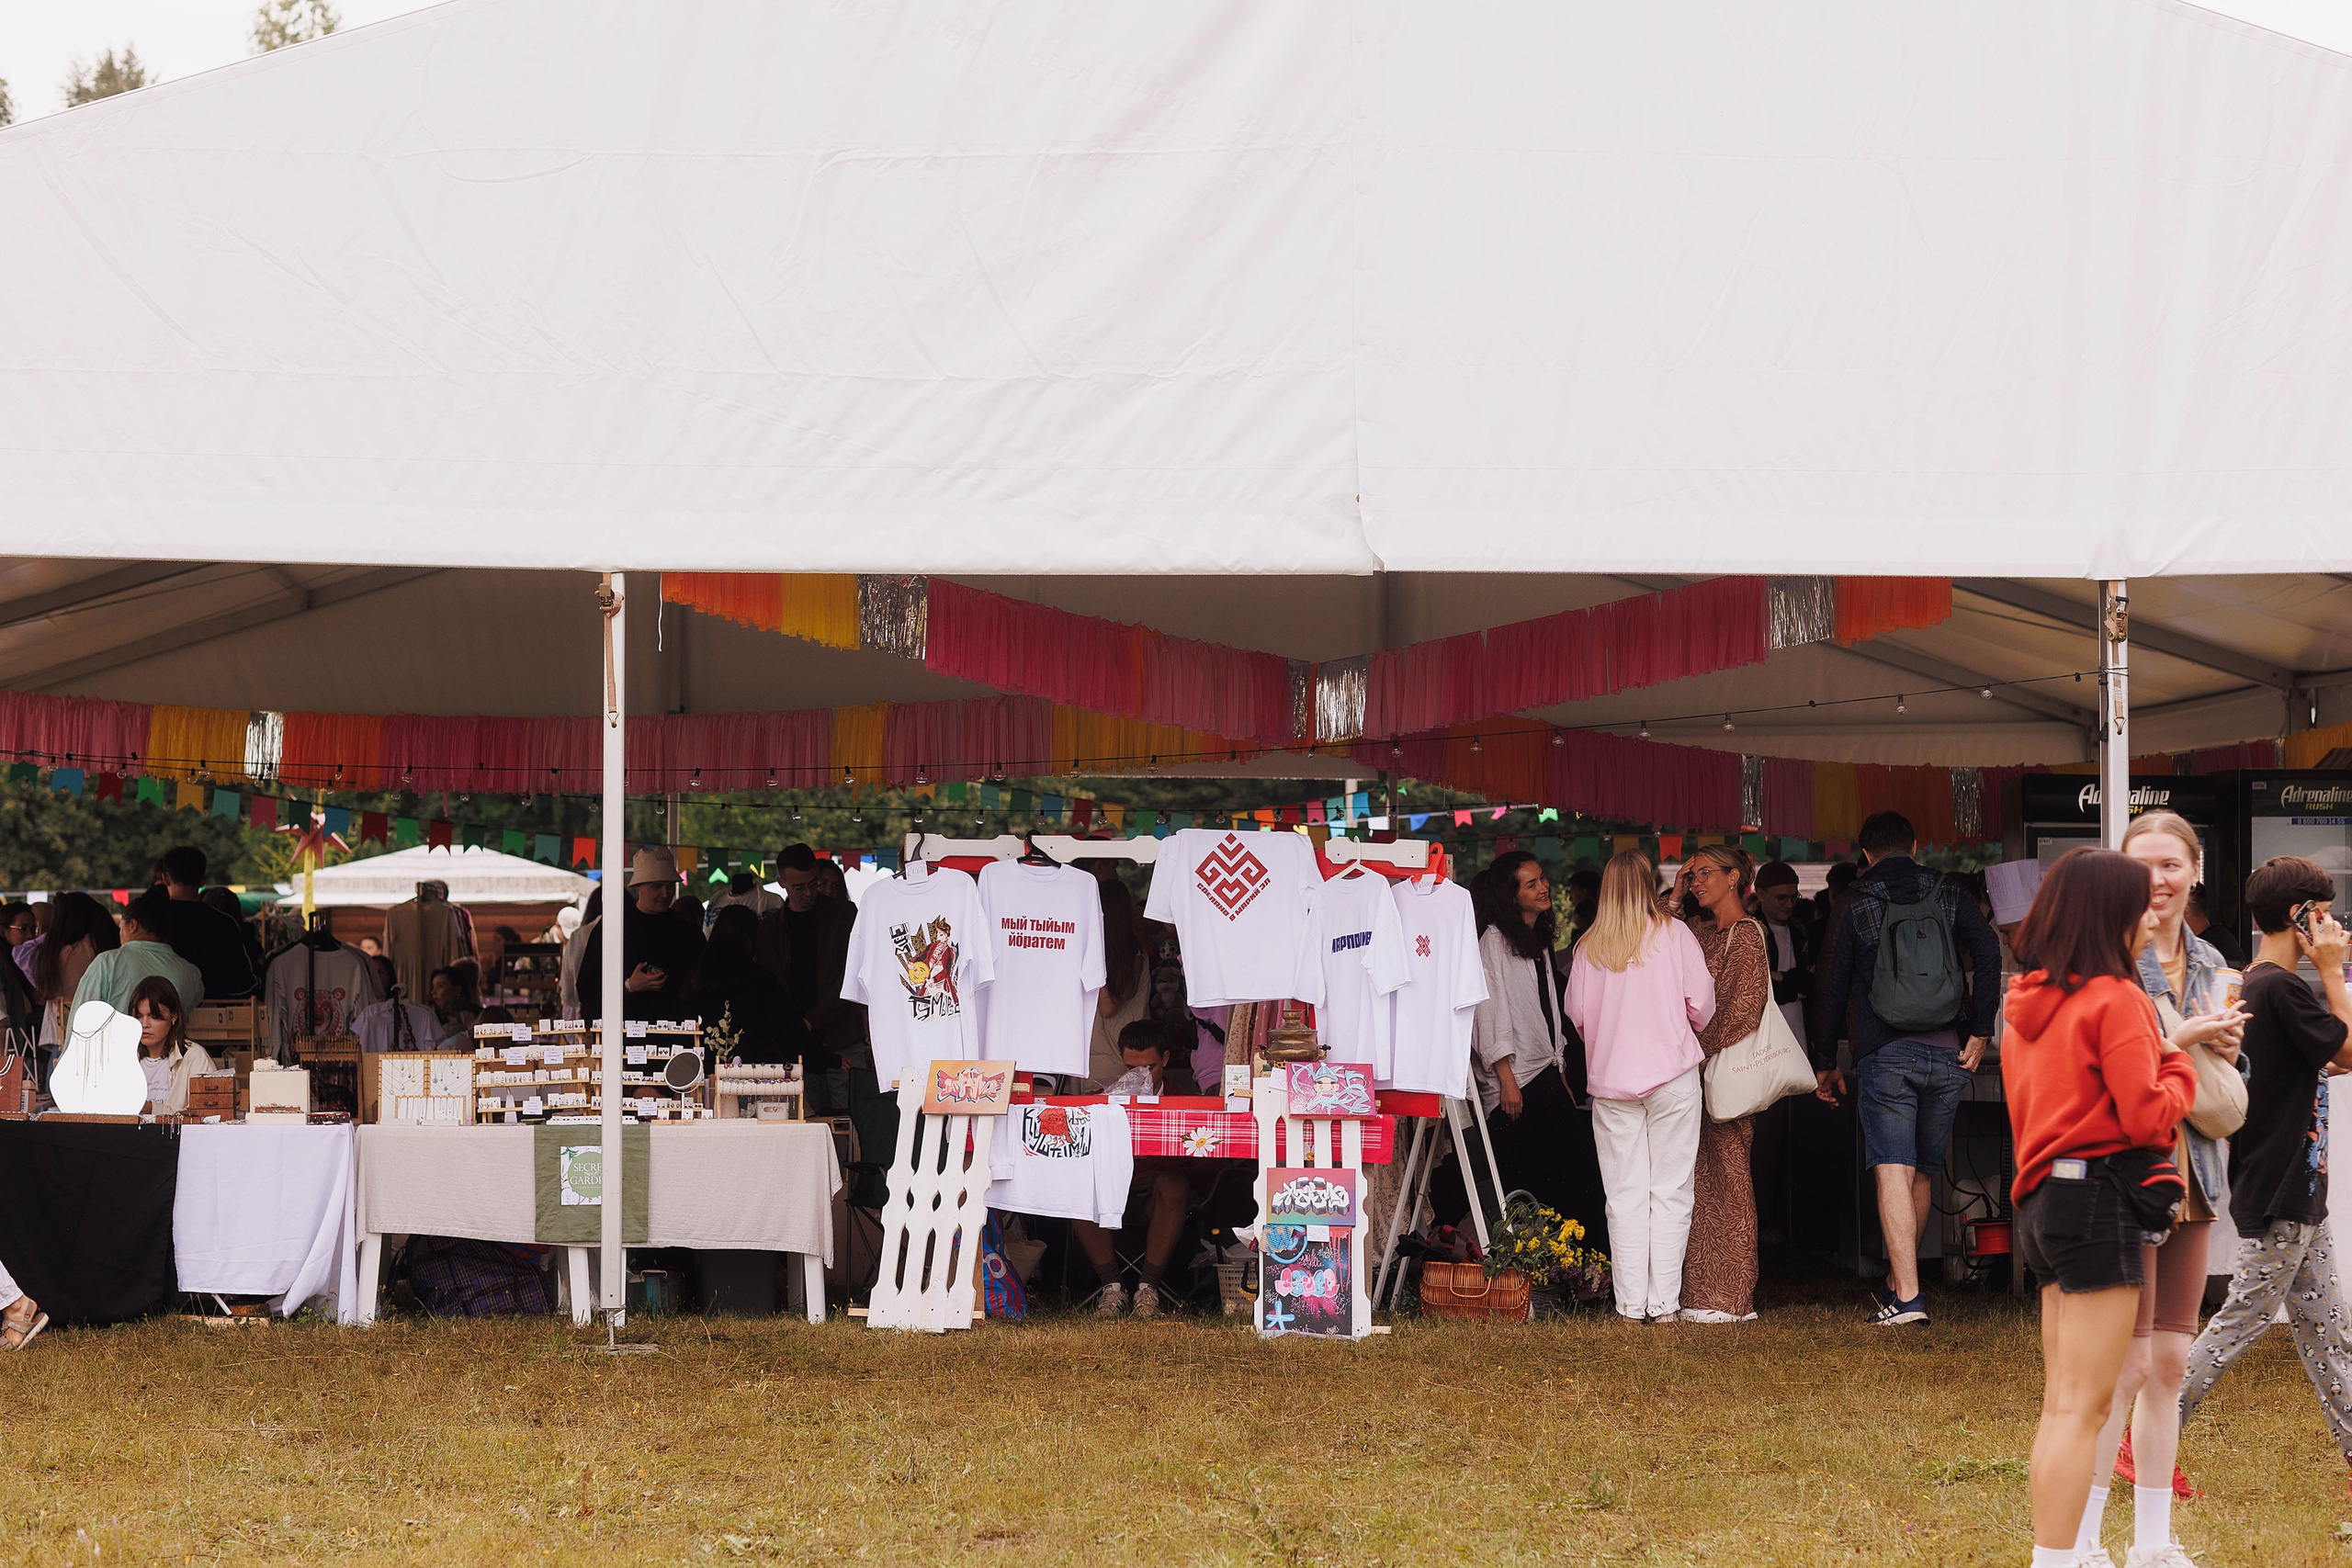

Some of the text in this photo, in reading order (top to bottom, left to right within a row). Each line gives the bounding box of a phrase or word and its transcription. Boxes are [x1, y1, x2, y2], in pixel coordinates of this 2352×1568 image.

[2280, 784, 2352, 809] Adrenaline
[1234, 886, 1261, 916] МАРИЙ
[1259, 877, 1271, 891] ЭЛ
[573, 1162, 602, 1172] SECRE
